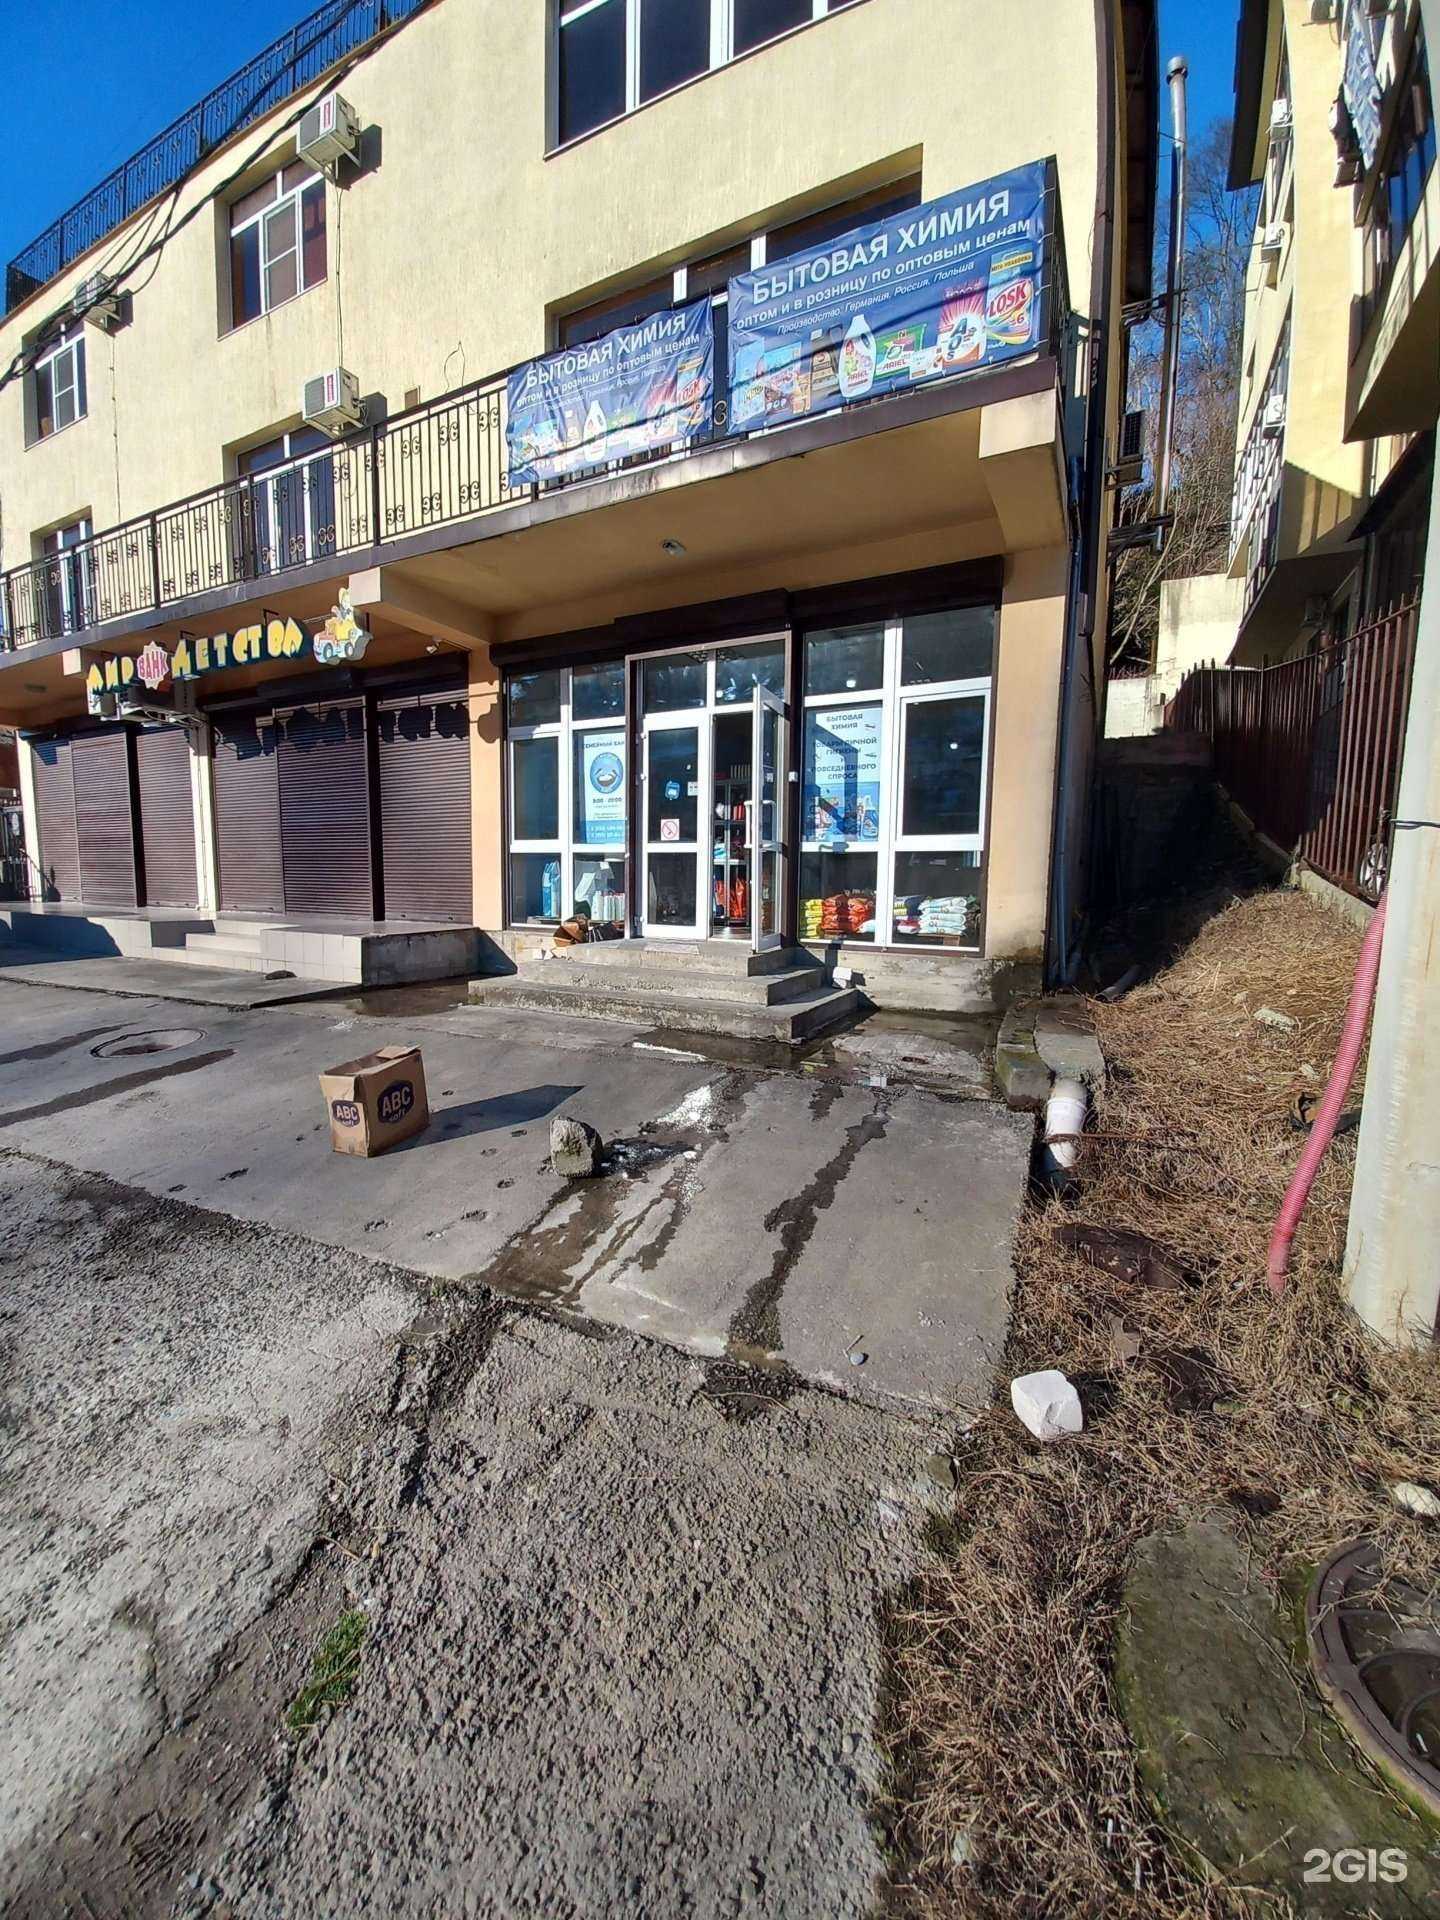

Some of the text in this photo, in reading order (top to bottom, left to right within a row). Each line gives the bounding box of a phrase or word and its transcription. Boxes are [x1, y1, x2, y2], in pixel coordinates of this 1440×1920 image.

[736, 309, 778, 330] оптом
[781, 303, 790, 314] и
[794, 299, 803, 311] в
[807, 275, 867, 308] розницу
[872, 267, 891, 283] по
[895, 239, 971, 275] оптовым
[976, 218, 1031, 249] ценам
[753, 189, 1009, 305] БЫТОВАЯ ХИМИЯ
[989, 282, 1028, 318] LOSK
[516, 391, 543, 408] оптом
[561, 369, 600, 396] розницу
[602, 366, 614, 379] по
[616, 347, 663, 372] оптовым
[664, 334, 700, 354] ценам
[526, 312, 686, 389] БЫТОВАЯ ХИМИЯ
[171, 616, 304, 680] ДЕТСТВА
[336, 1105, 358, 1120] ABC
[382, 1086, 411, 1117] ABC
